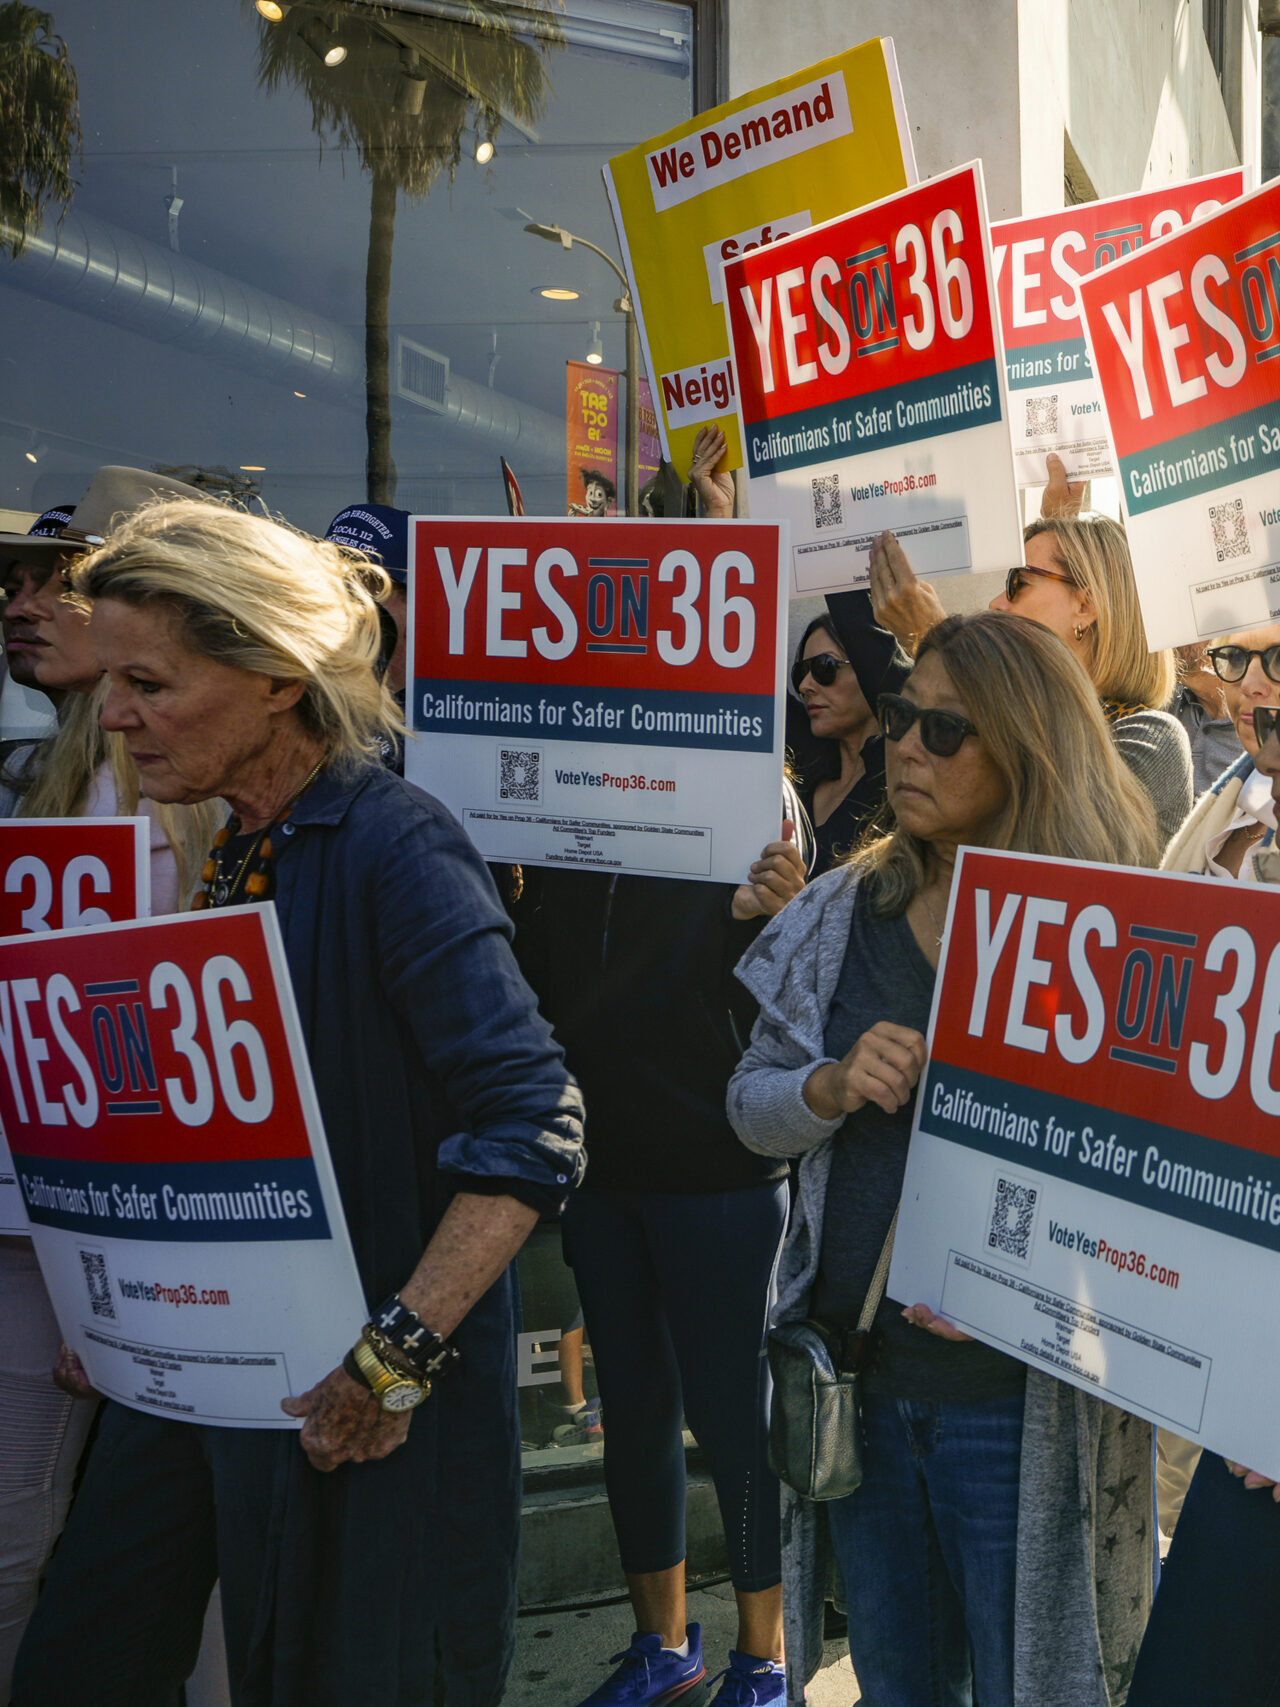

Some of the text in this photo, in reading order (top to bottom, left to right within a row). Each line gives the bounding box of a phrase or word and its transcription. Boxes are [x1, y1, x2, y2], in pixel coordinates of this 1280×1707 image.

[650, 83, 835, 188] We Demand
[739, 208, 974, 394] YES ON 36
[1101, 253, 1248, 421] YES
[1057, 352, 1079, 372] for
[752, 384, 992, 462] Californians for Safer Communities
[851, 473, 937, 501] VoteYesProp36.com
[1129, 450, 1228, 498] Californians
[1230, 435, 1255, 466] for
[333, 526, 374, 542] LOCAL 112
[434, 546, 757, 669] YES ON 36
[423, 693, 763, 738] Californians for Safer Communities
[555, 769, 676, 793] VoteYesProp36.com
[4, 855, 111, 932] 36
[968, 888, 1118, 1065] YES
[1116, 948, 1194, 1050] ON
[91, 1003, 158, 1093] ON
[149, 954, 274, 1127] 36
[931, 1082, 1038, 1148] Californians
[1045, 1116, 1076, 1156] for
[1078, 1126, 1137, 1177] Safer
[22, 1173, 313, 1221] Californians for Safer Communities
[1049, 1219, 1180, 1290] VoteYesProp36.com
[118, 1278, 230, 1308] VoteYesProp36.com
